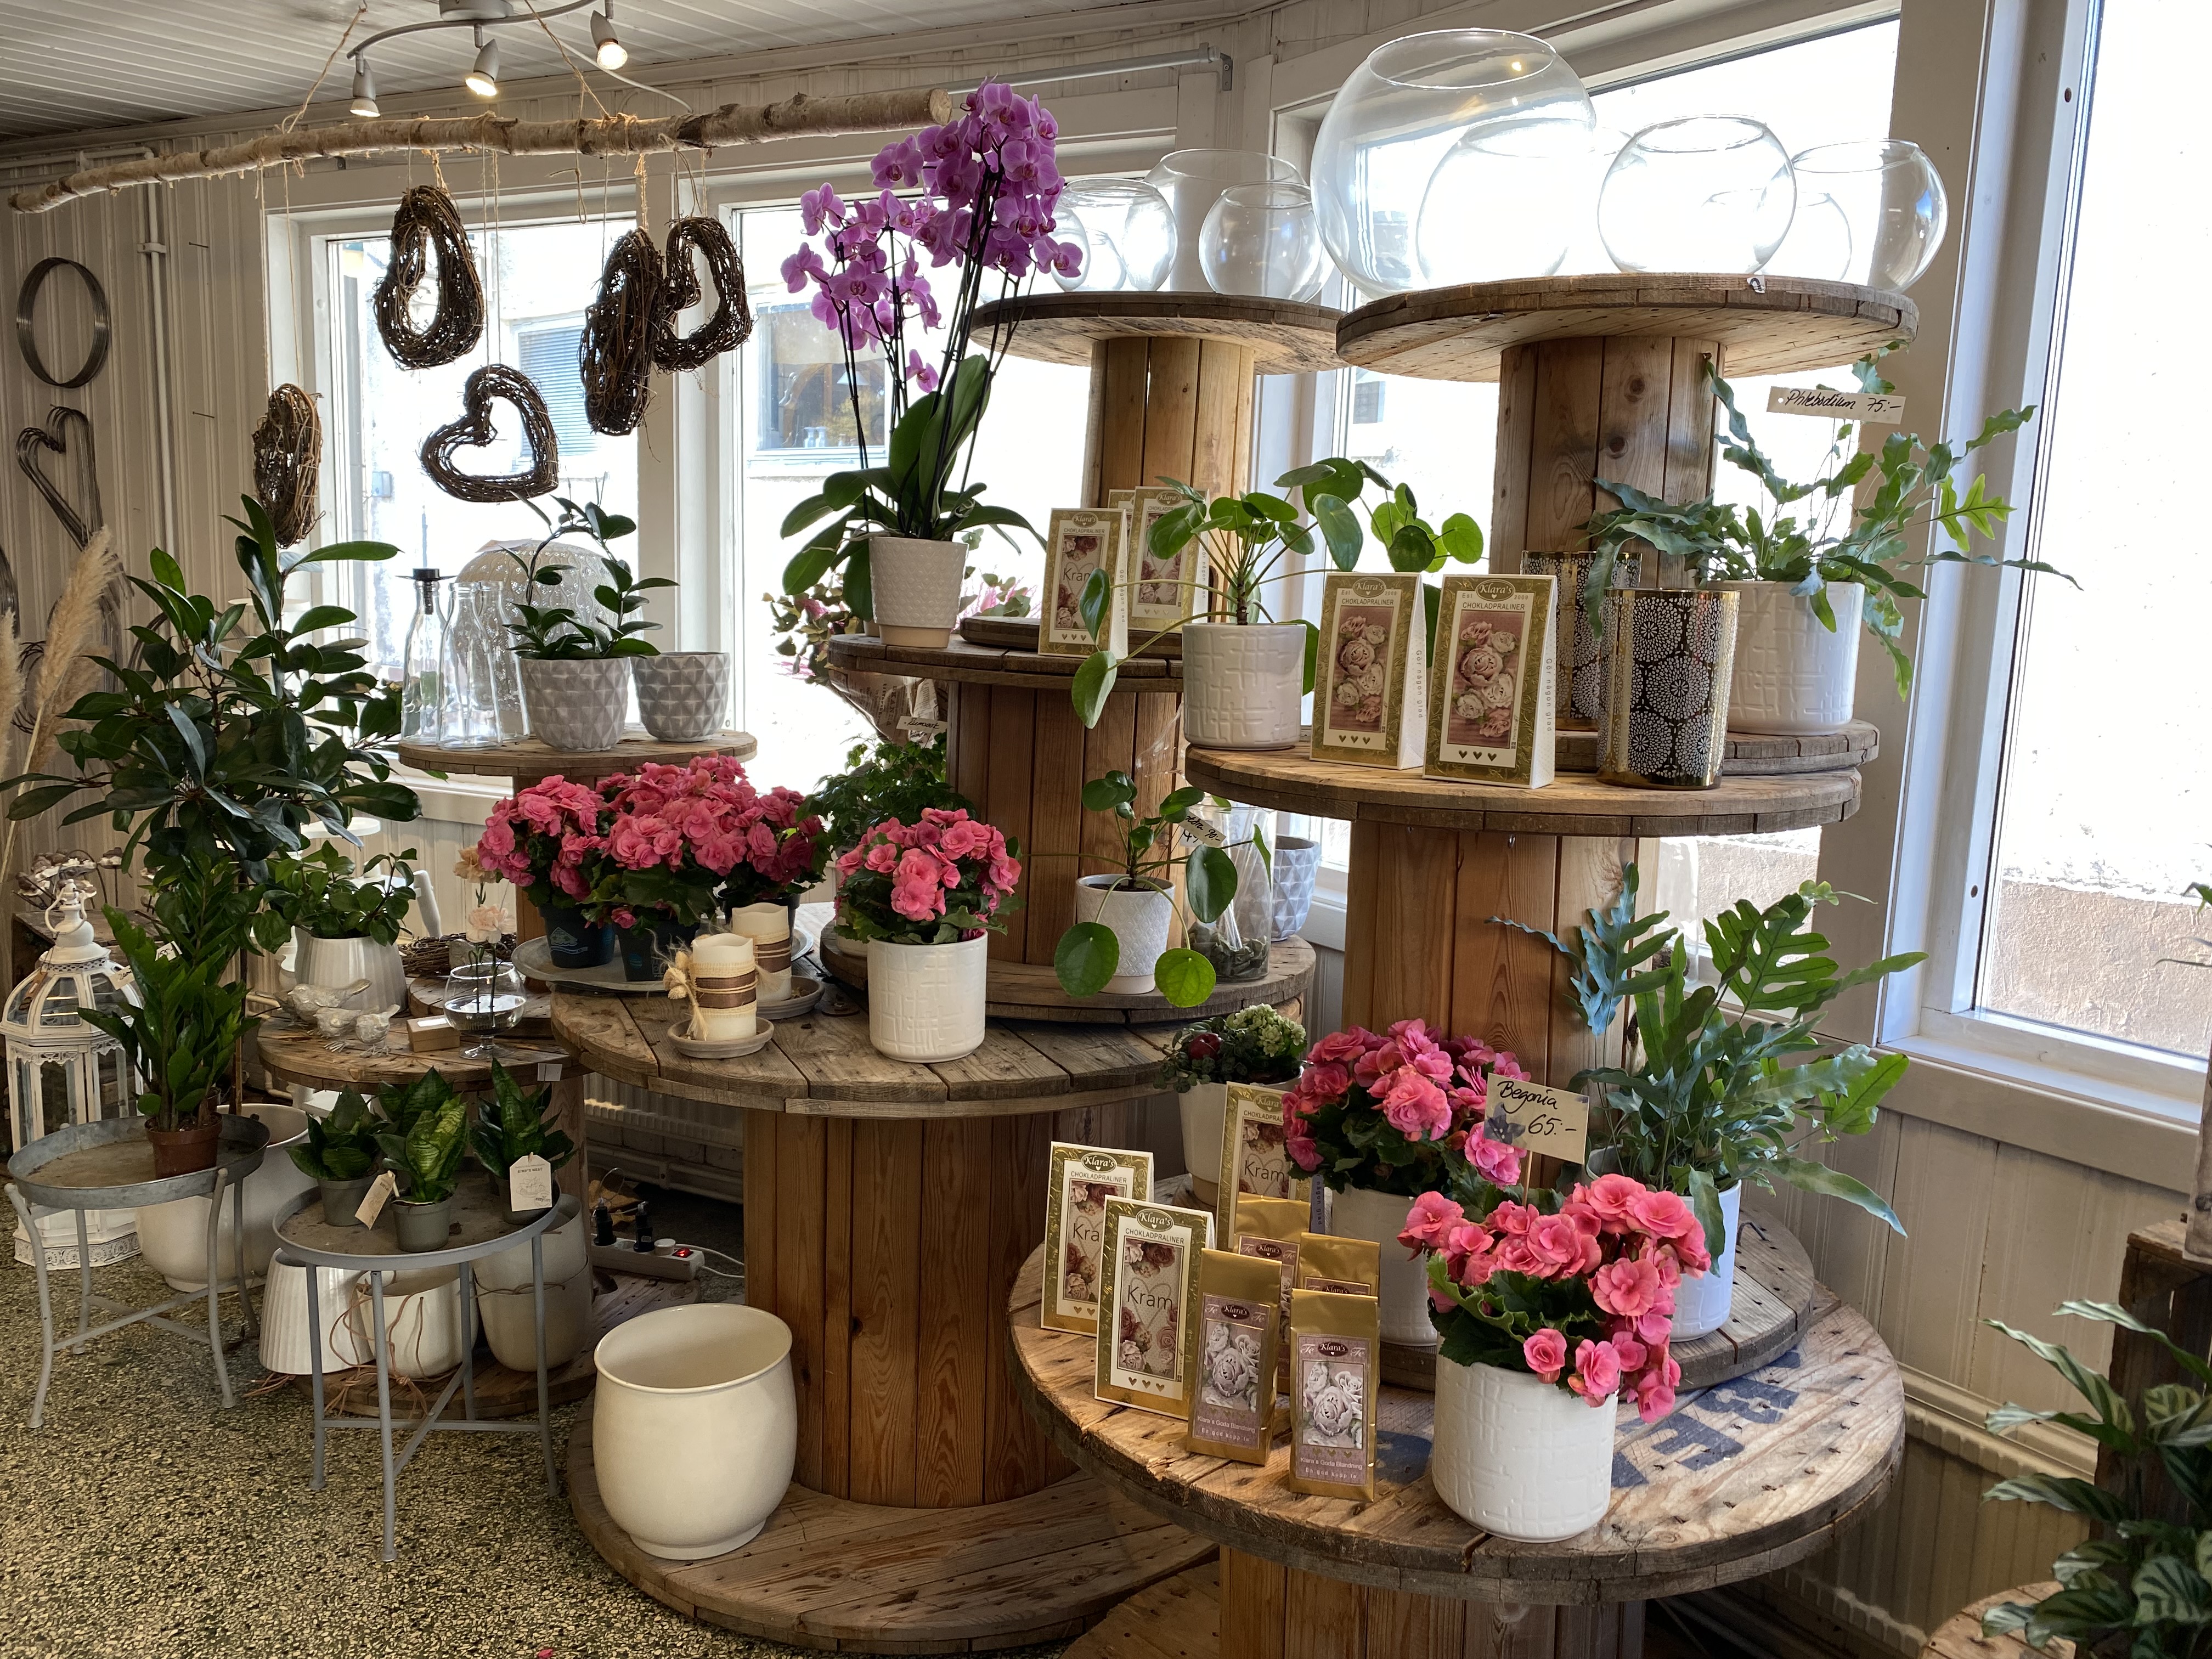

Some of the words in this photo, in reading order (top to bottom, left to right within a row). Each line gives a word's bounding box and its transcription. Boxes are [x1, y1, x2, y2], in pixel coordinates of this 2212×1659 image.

[1867, 397, 1902, 413] 75:-
[1158, 493, 1181, 501] Klara's
[1075, 514, 1096, 522] Klara's
[1355, 580, 1384, 591] Klara's
[1480, 582, 1513, 595] Klara's
[1462, 602, 1525, 611] CHOKLADPRALINER
[1256, 1097, 1282, 1108] Klara'
[1497, 1081, 1558, 1114] Begonia
[1243, 1110, 1283, 1122] CHOKLADPRAL
[1528, 1114, 1577, 1136] 65:-
[1084, 1155, 1115, 1167] Klara's
[1070, 1171, 1127, 1183] CHOKLADPRALINER
[1244, 1160, 1285, 1183] Kram
[1139, 1212, 1171, 1226] Klara's
[1073, 1222, 1100, 1243] Kra
[1125, 1228, 1184, 1244] CHOKLADPRALINER
[1258, 1244, 1280, 1253] Klara's
[1127, 1285, 1173, 1311] Kram
[1223, 1305, 1248, 1315] Klara's
[1320, 1342, 1346, 1351] Klara's
[1231, 1423, 1256, 1434] Blandning
[1336, 1461, 1363, 1470] Blandning
